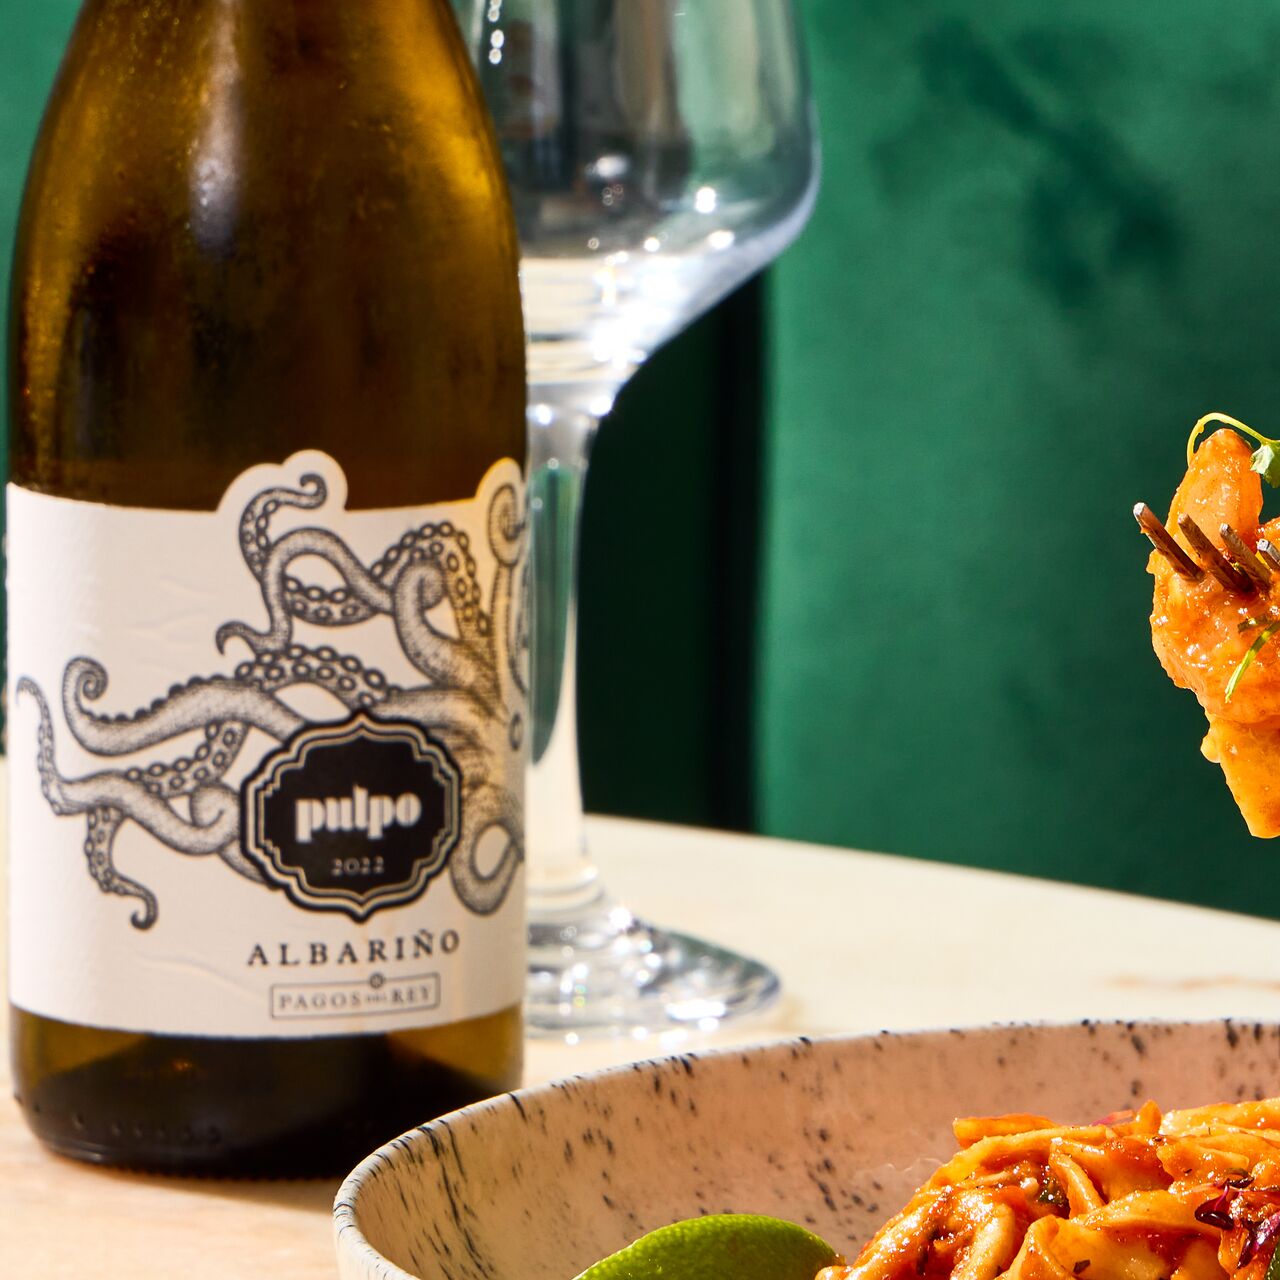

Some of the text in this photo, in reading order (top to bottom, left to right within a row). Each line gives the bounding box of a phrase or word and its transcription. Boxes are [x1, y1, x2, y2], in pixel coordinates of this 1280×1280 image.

[295, 784, 421, 842] pulpo
[331, 856, 384, 875] 2022
[248, 928, 460, 966] ALBARIÑO
[279, 991, 361, 1010] PAGOS
